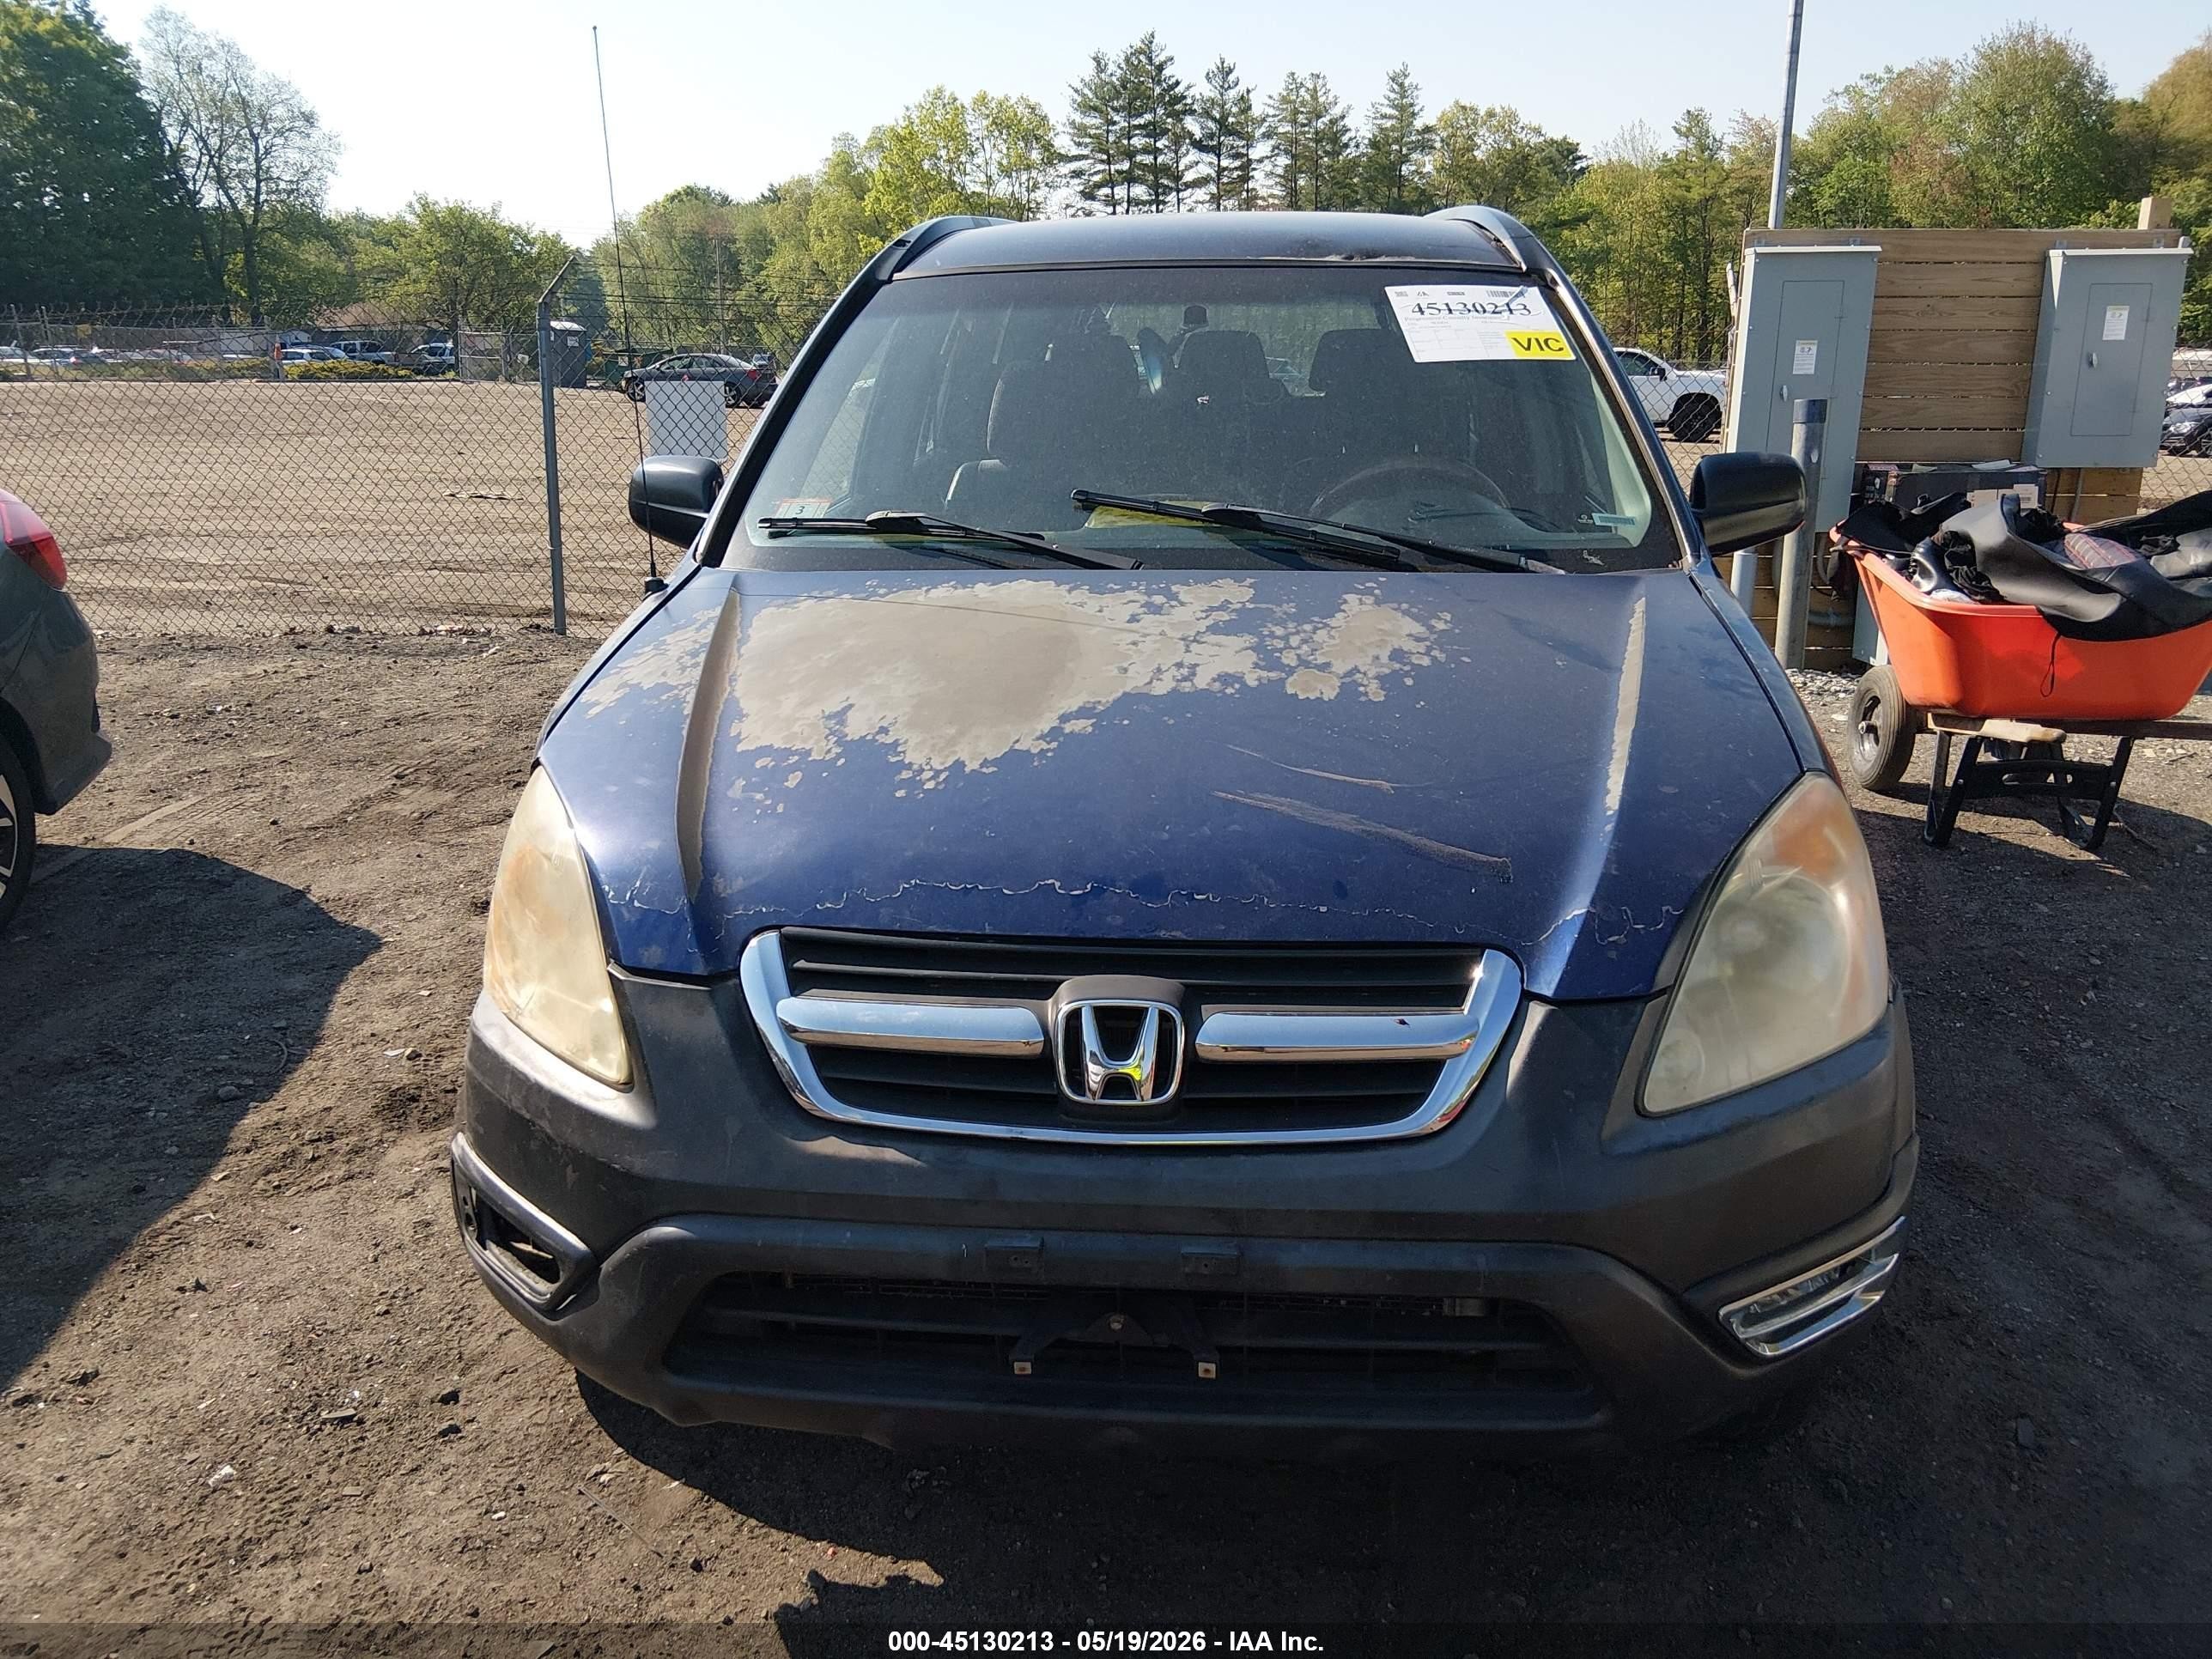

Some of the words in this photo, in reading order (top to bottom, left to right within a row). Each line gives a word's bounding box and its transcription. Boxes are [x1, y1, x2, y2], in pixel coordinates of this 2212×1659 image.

[1412, 302, 1532, 316] 45130213
[1512, 337, 1565, 352] VIC
[796, 506, 805, 515] 3
